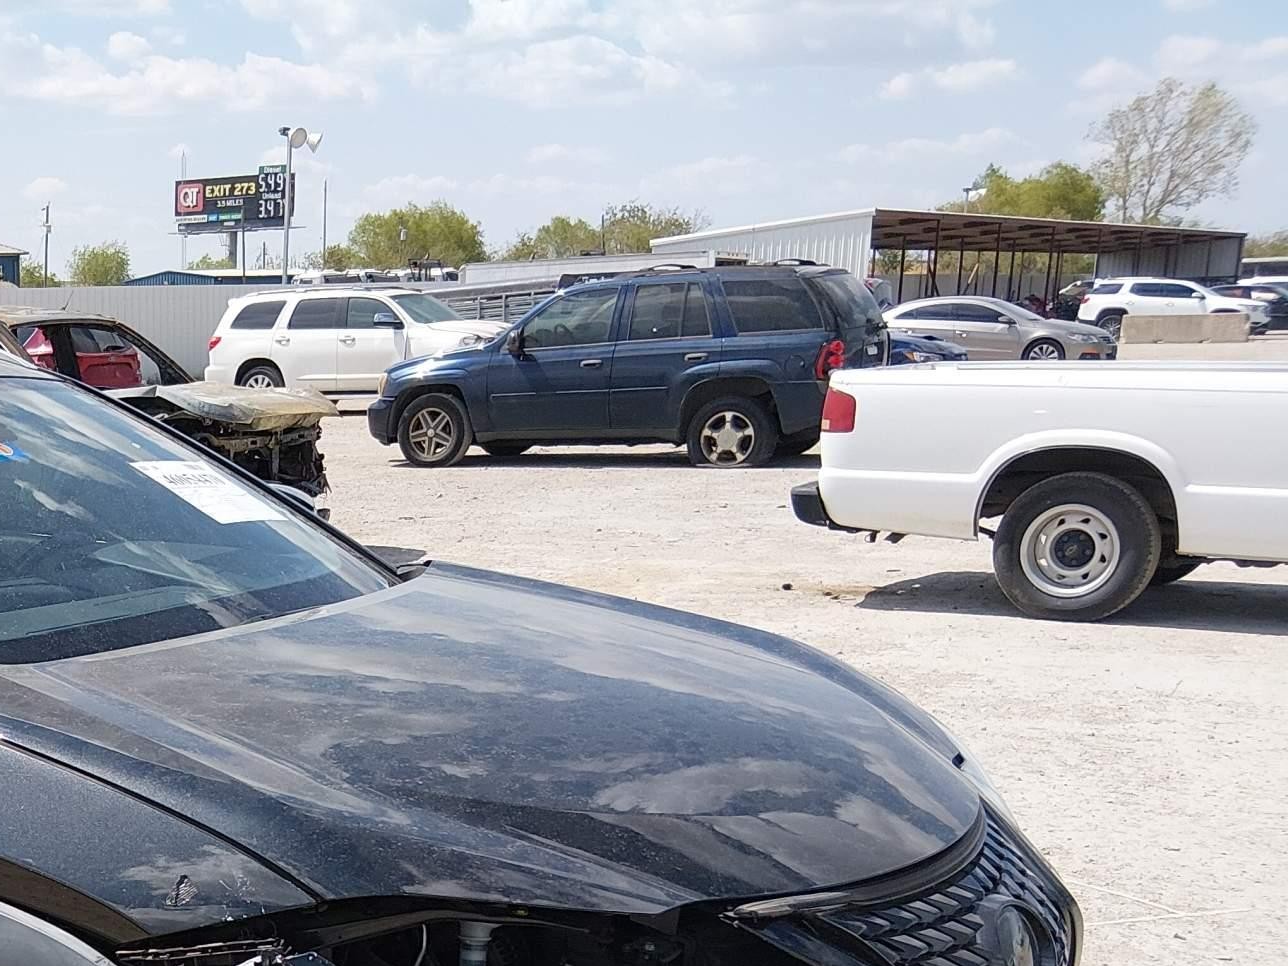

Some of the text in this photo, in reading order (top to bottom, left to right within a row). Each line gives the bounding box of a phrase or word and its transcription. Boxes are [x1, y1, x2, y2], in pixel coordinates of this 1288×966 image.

[205, 182, 256, 198] EXIT 273
[258, 173, 284, 192] 5.49
[180, 187, 200, 208] QT
[258, 200, 283, 218] 3.47
